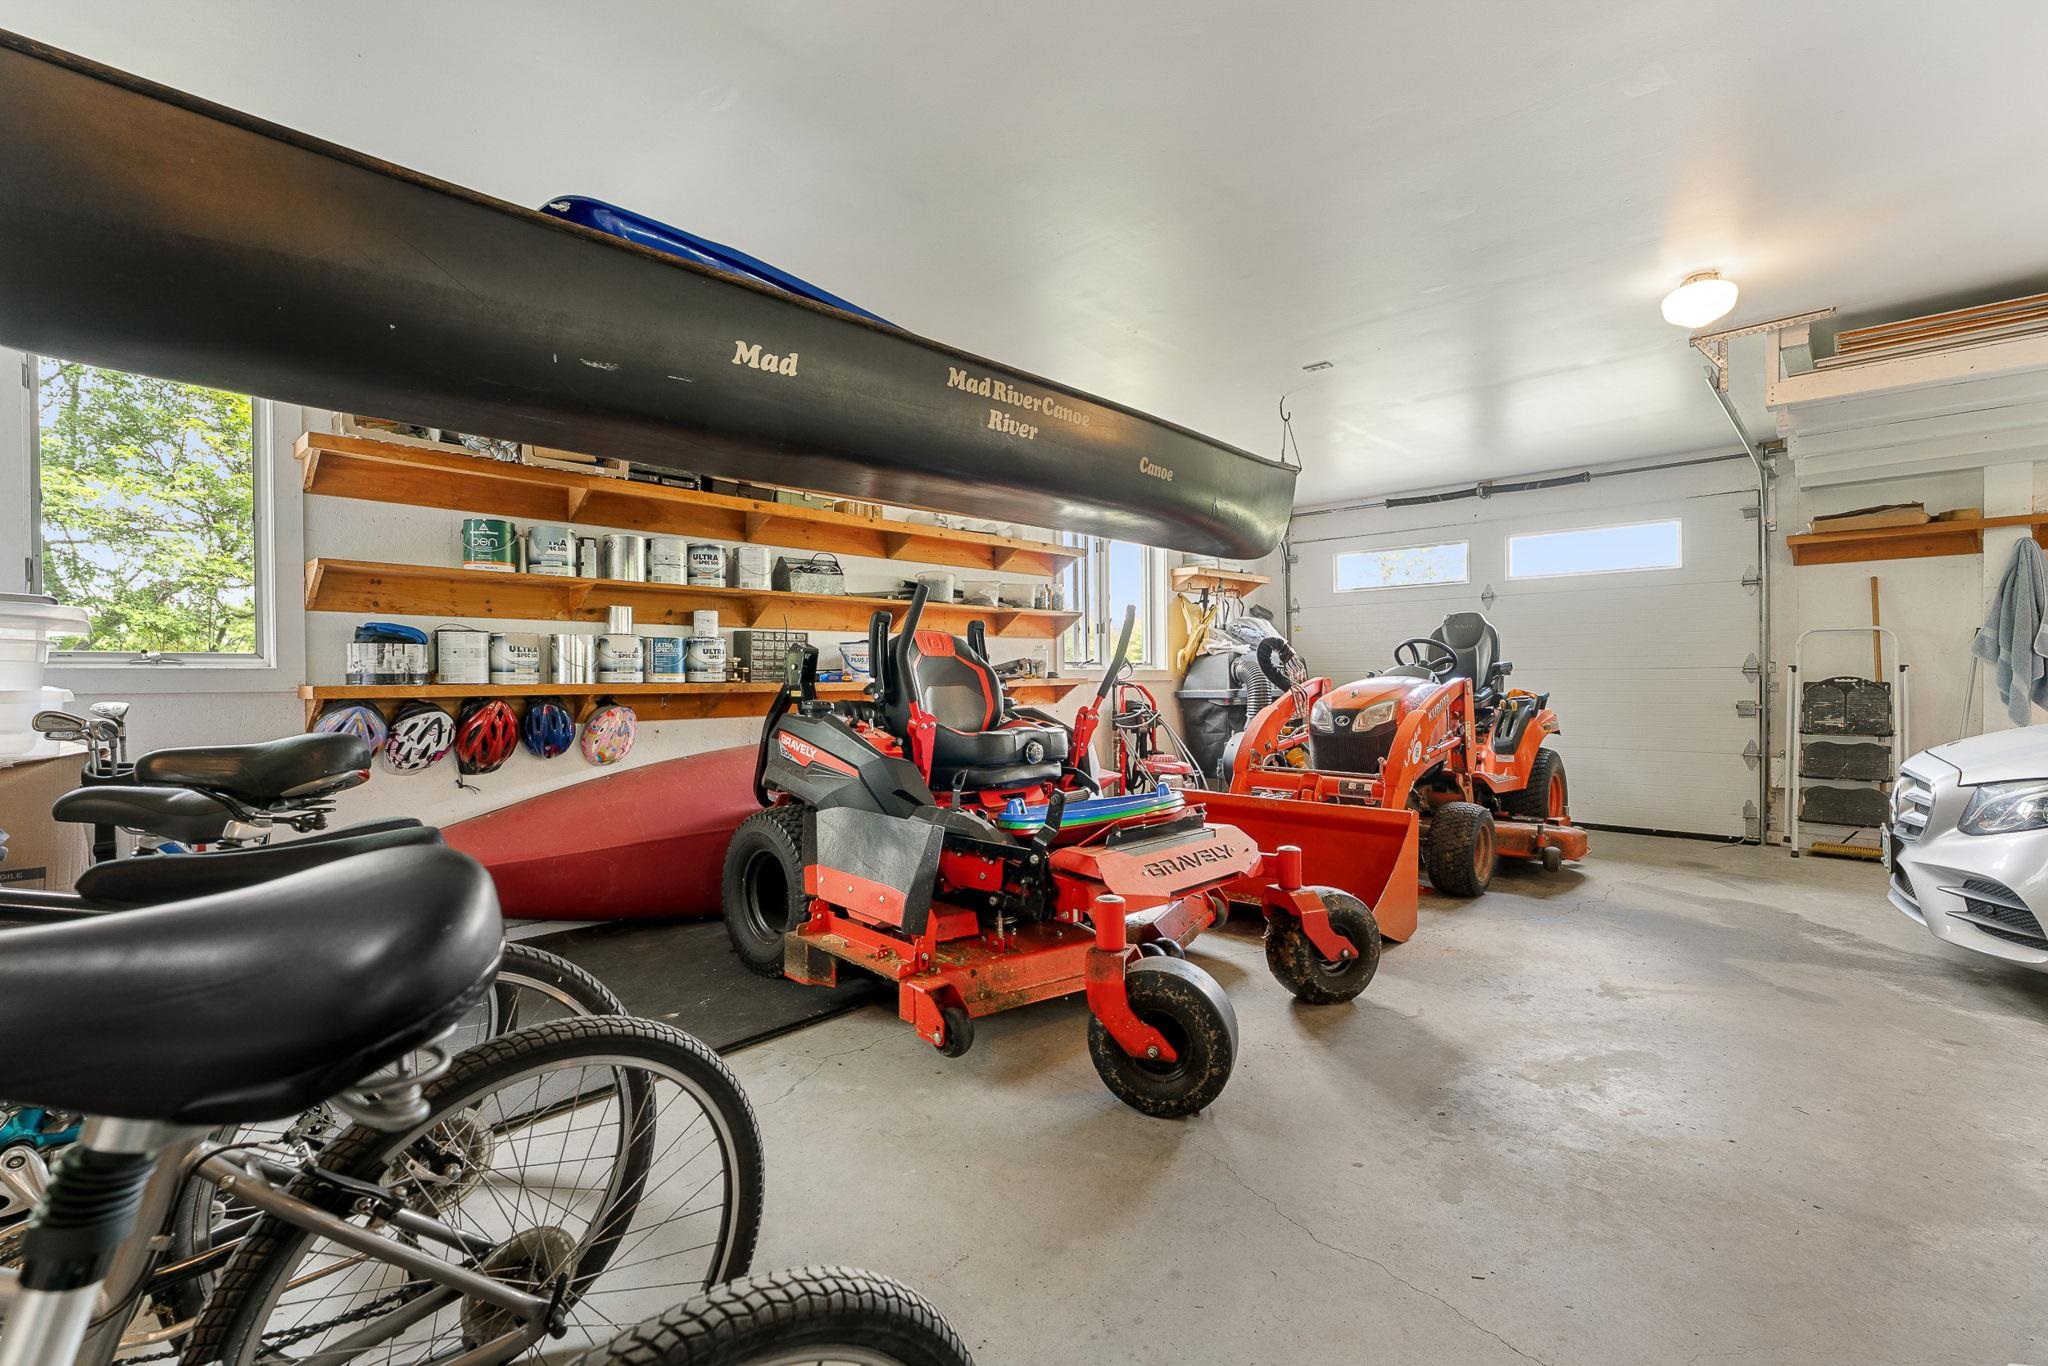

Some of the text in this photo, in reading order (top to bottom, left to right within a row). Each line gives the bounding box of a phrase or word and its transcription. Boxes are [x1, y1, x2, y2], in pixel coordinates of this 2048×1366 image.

[732, 340, 799, 377] Mad
[947, 366, 1090, 427] Mad River Canoe
[987, 409, 1039, 440] River
[1139, 456, 1174, 482] Canoe
[471, 534, 498, 547] ben
[692, 553, 719, 561] ULTRA
[509, 645, 538, 653] ULTRA
[1427, 692, 1451, 721] KUBOTA
[781, 733, 818, 759] GRAVELY
[1143, 844, 1233, 877] GRAVELY
